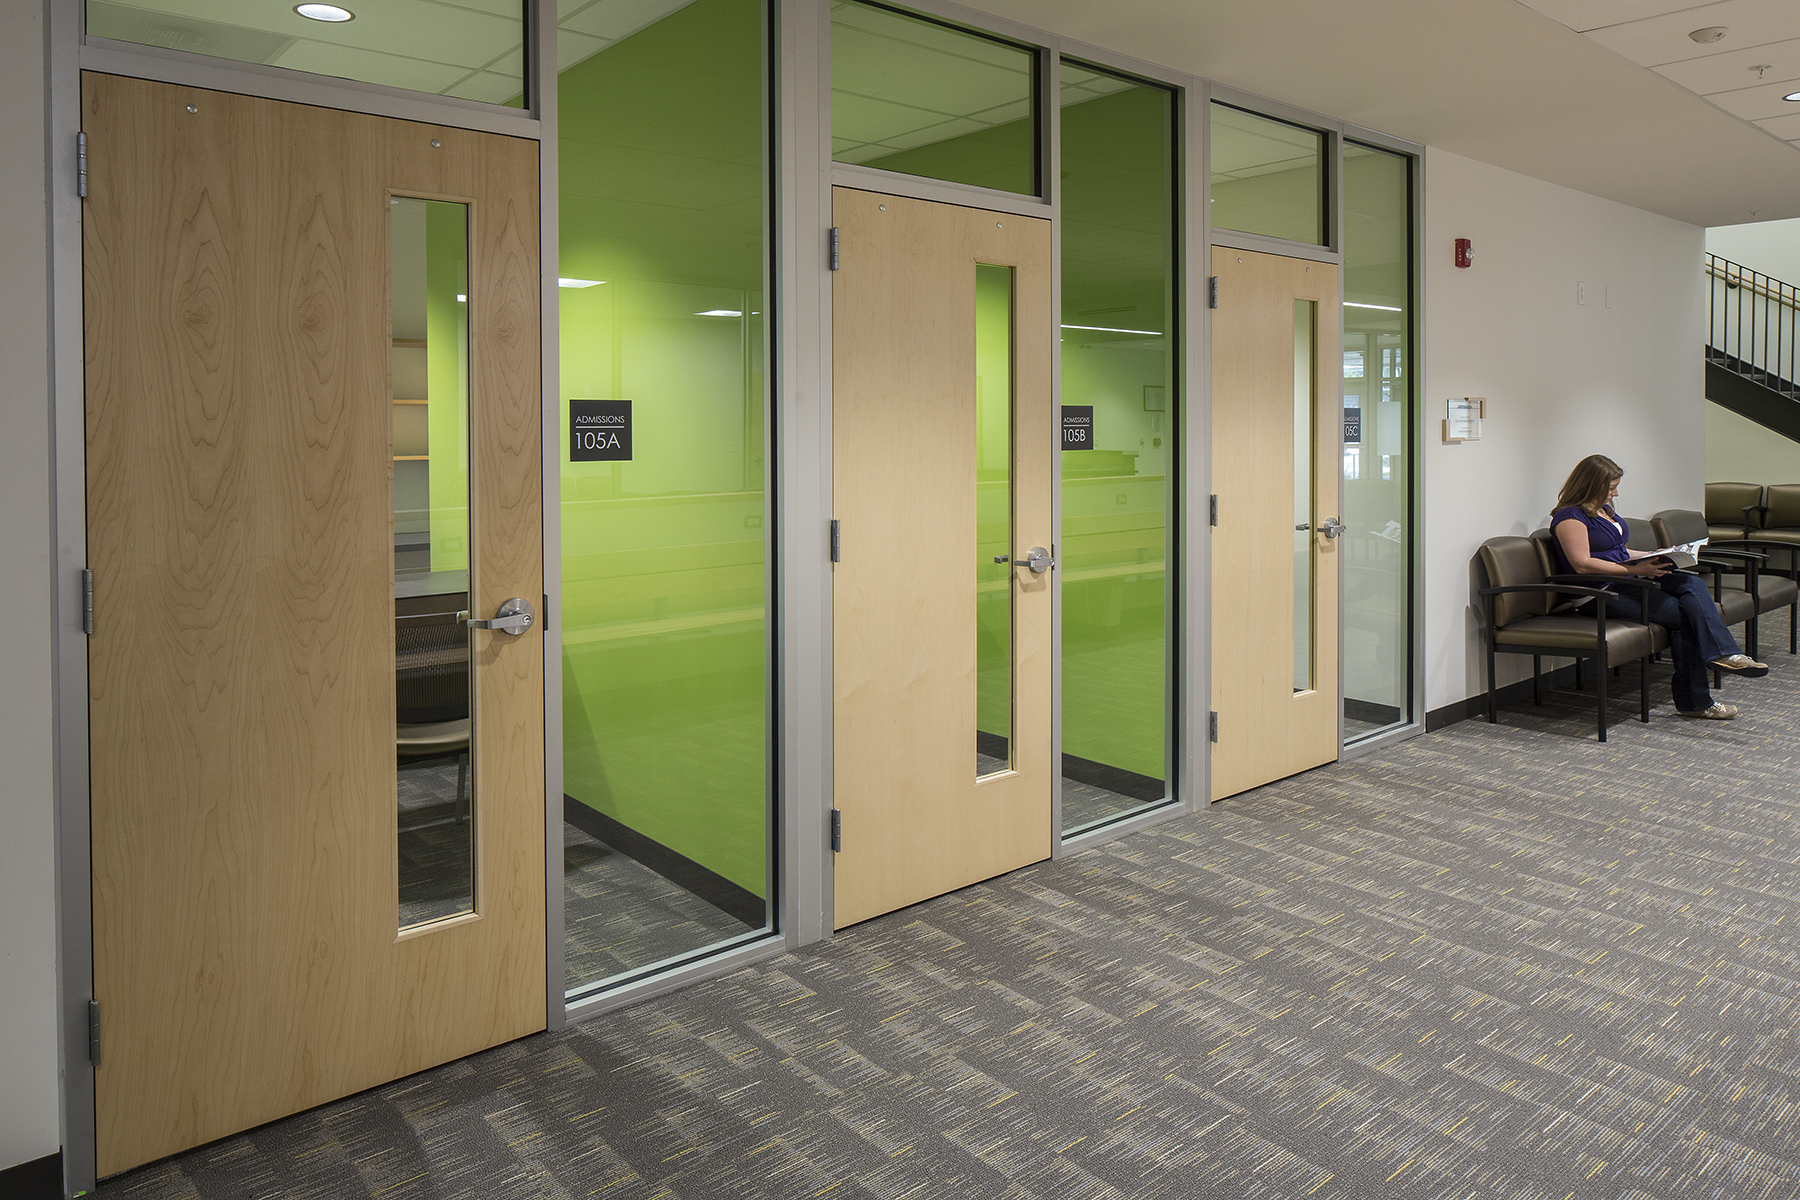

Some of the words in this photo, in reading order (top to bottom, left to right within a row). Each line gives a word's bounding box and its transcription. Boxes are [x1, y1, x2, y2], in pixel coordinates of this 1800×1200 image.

[575, 415, 625, 424] ADMISSIONS
[1063, 429, 1086, 442] 105B
[1345, 425, 1359, 437] 05C
[575, 432, 621, 450] 105A
